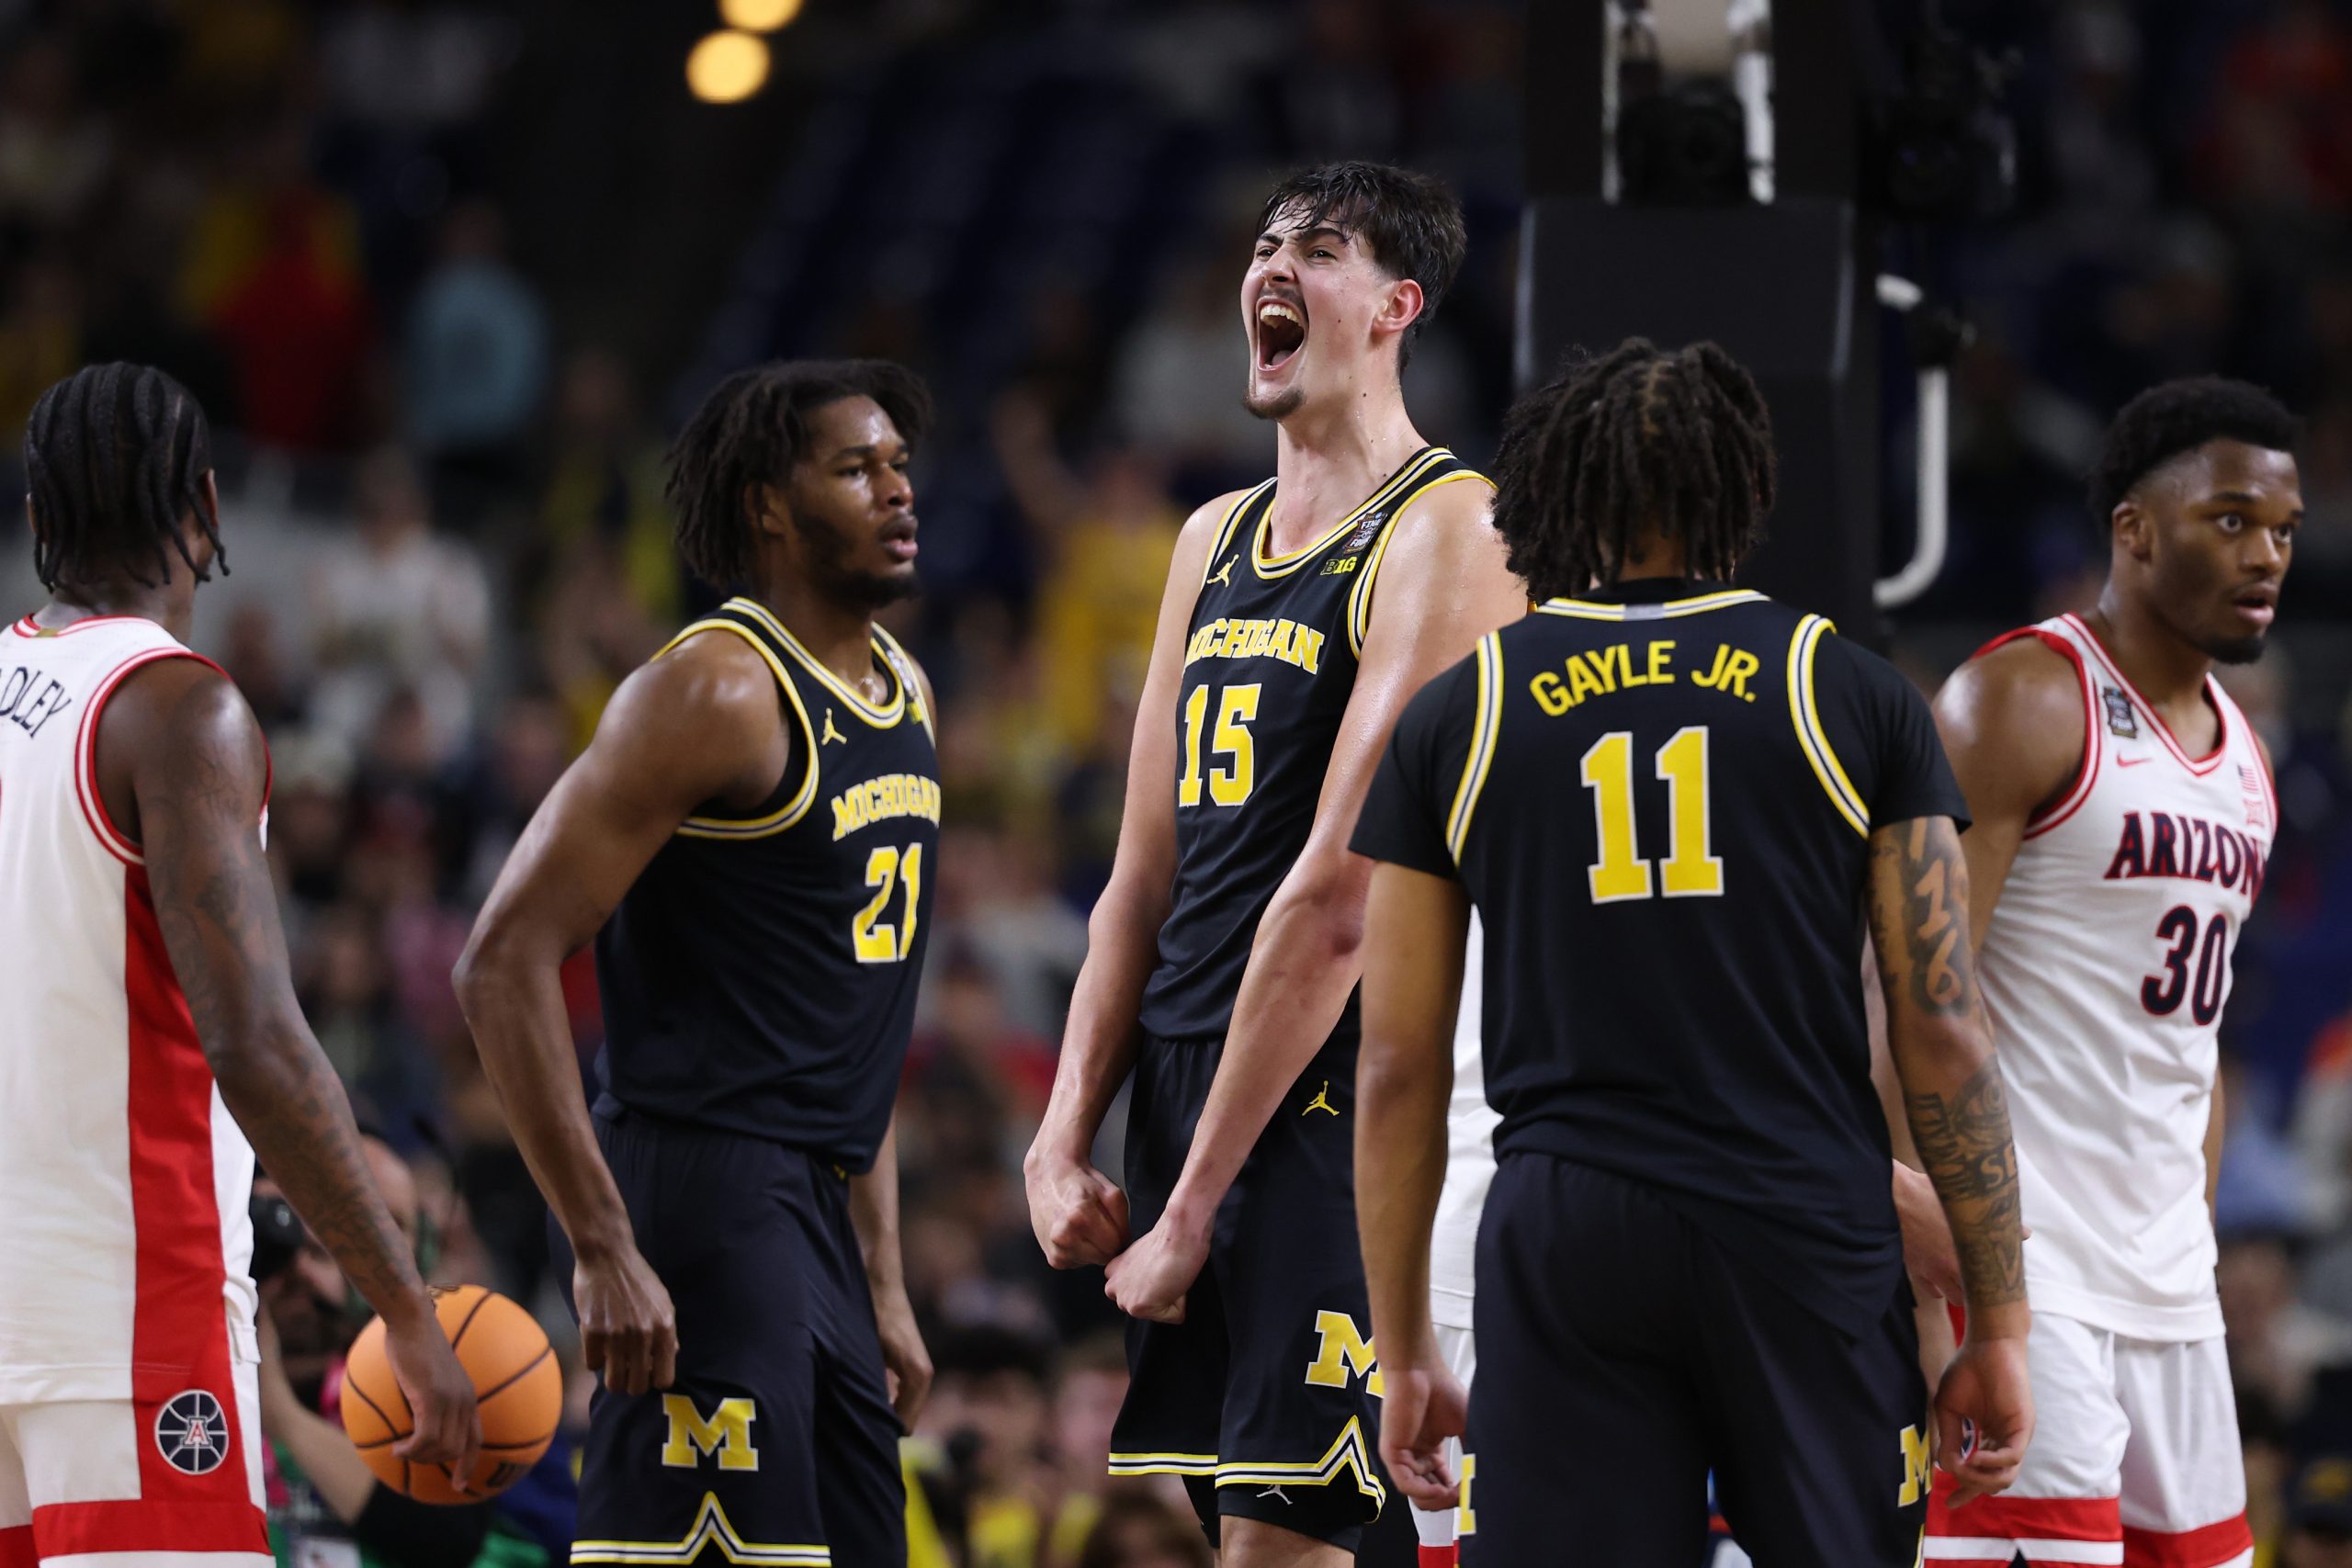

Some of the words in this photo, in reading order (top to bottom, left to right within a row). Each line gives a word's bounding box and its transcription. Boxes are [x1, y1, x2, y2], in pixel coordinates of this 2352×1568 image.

[0, 666, 72, 739] DLEY
[1529, 640, 1676, 716] GAYLE
[1690, 643, 1760, 703] JR.
[1179, 682, 1262, 807] 15
[1580, 726, 1724, 905] 11
[2103, 810, 2267, 905] ARIZON
[852, 842, 922, 964] 21
[2141, 905, 2228, 1027] 30
[181, 1416, 212, 1449] A
[662, 1393, 759, 1472] M
